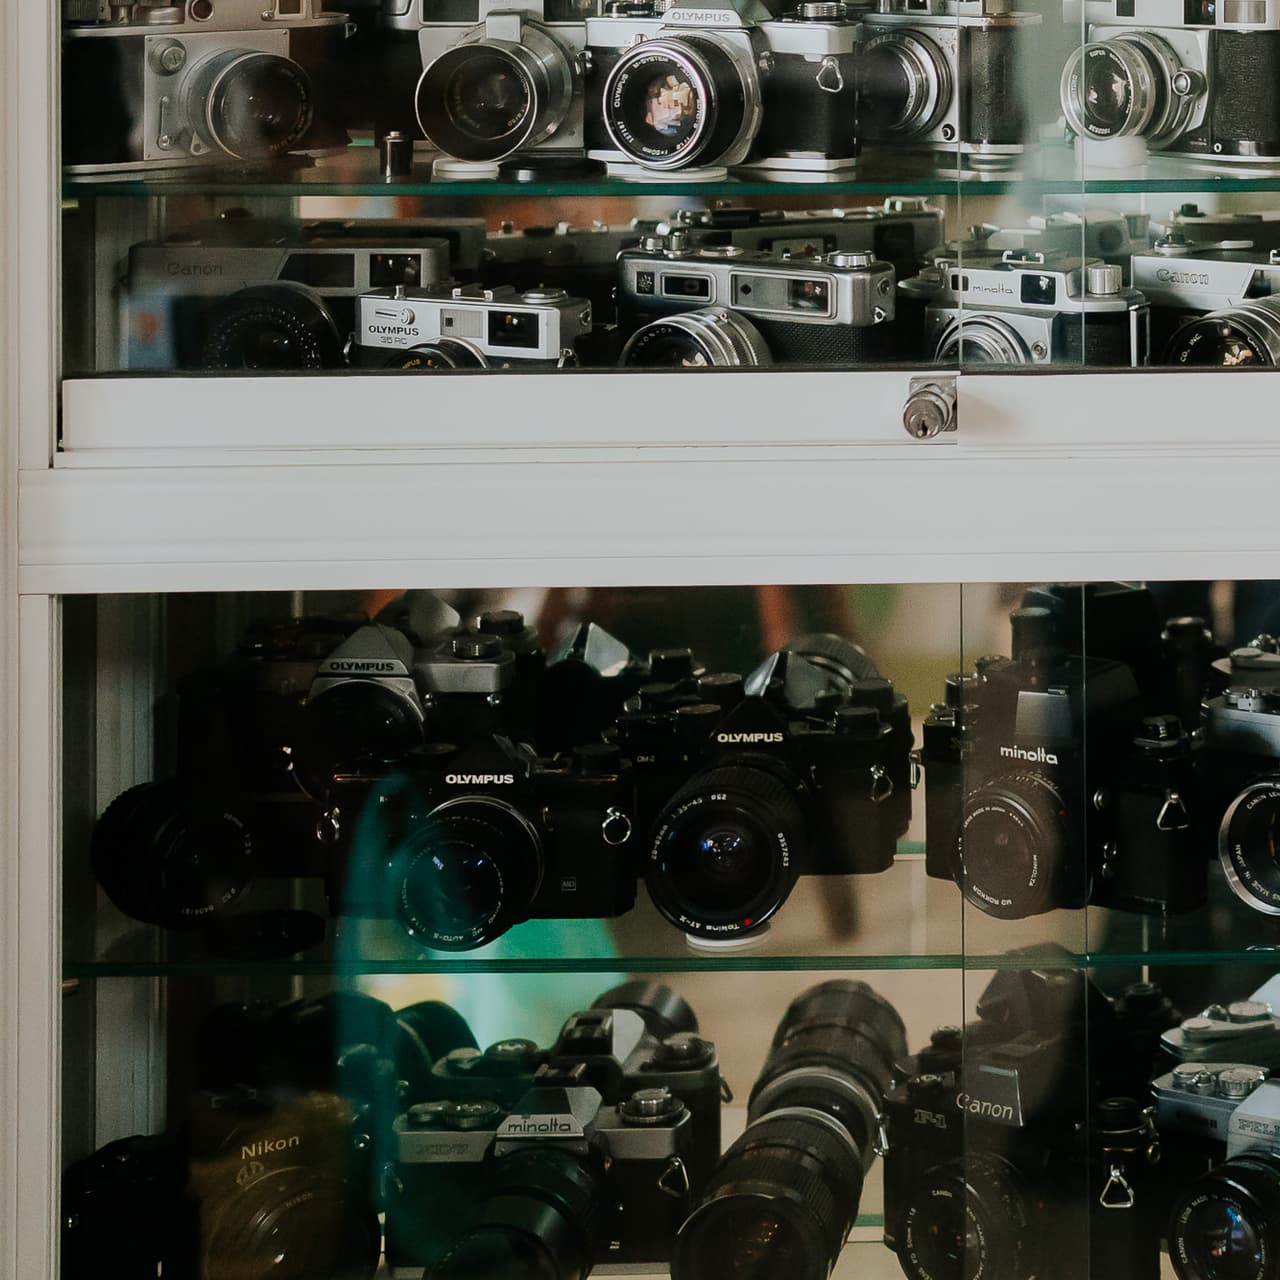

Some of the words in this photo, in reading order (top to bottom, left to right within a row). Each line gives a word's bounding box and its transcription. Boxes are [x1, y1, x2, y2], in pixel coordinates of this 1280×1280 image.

[671, 11, 731, 24] OLYMPUS
[165, 262, 223, 277] Canon
[1156, 268, 1210, 286] Canon
[972, 282, 1014, 295] minolta
[368, 324, 420, 338] OLYMPUS
[329, 661, 395, 672] OLYMPUS
[717, 732, 784, 744] OLYMPUS
[1000, 744, 1059, 766] minolta
[445, 773, 515, 785] OLYMPUS
[955, 1091, 1014, 1121] Canon
[507, 1121, 573, 1134] minolta
[240, 1135, 300, 1162] Nikon
